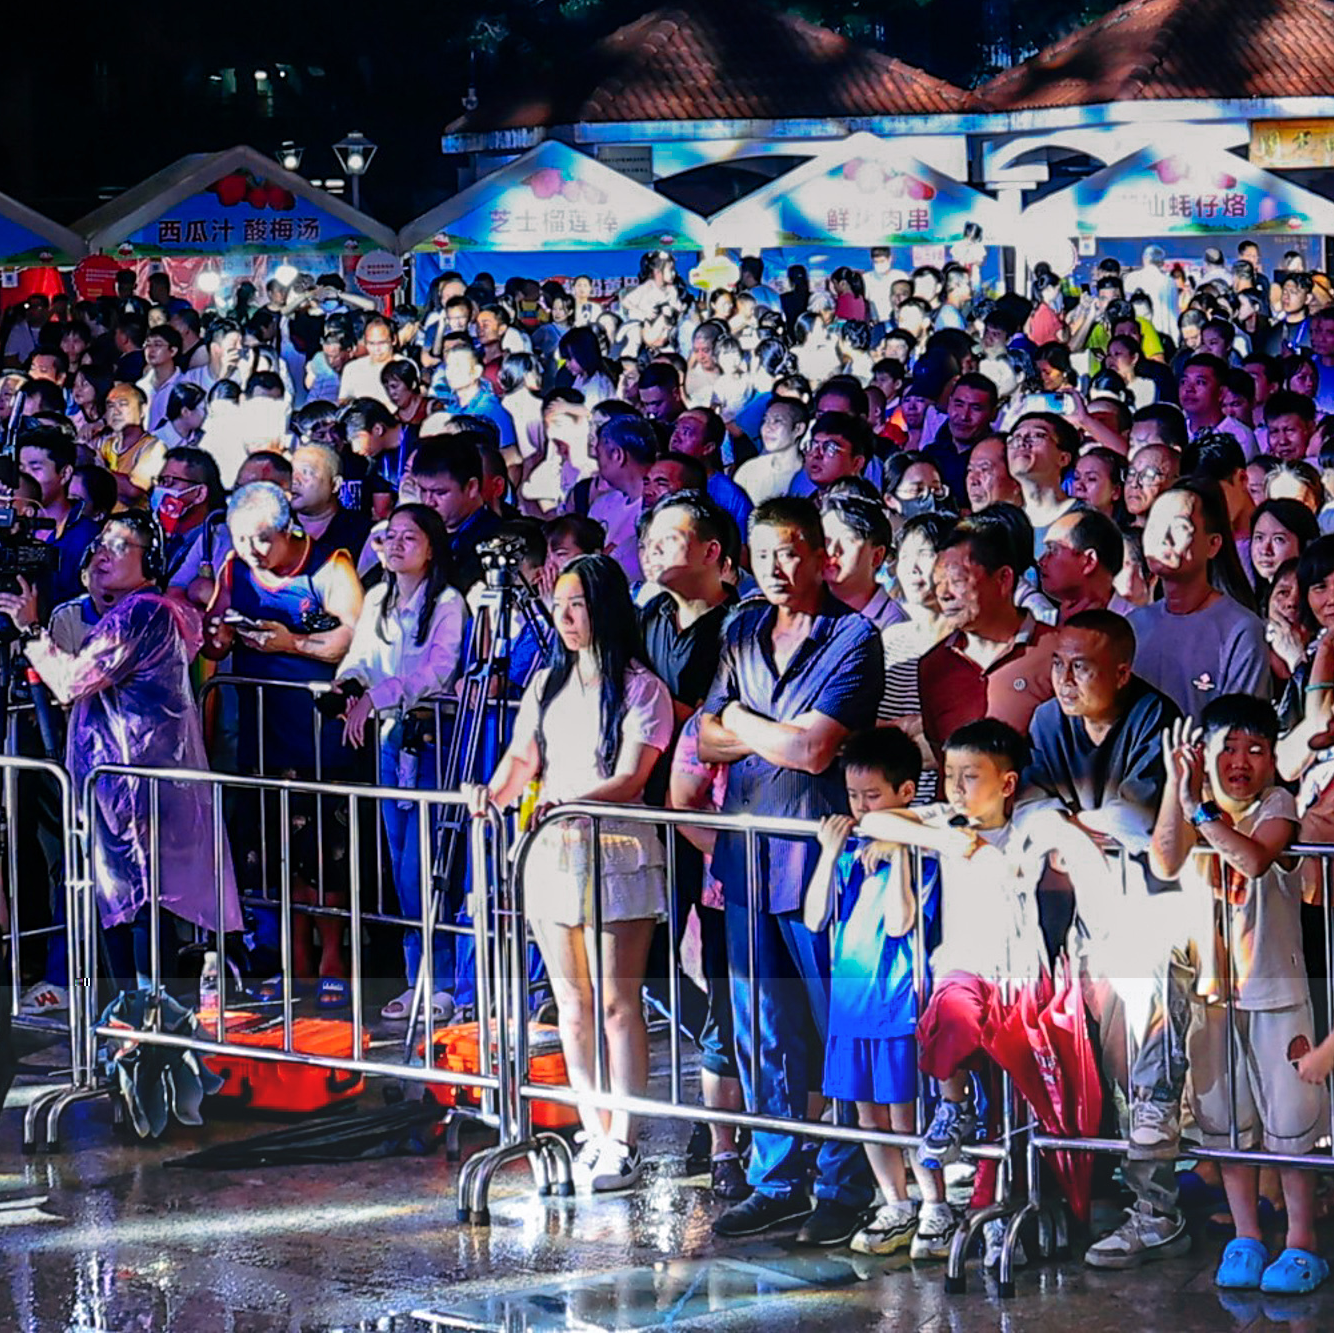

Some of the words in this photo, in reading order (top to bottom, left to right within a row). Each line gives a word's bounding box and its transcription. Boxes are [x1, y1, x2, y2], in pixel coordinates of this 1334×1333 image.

[158, 219, 236, 244] 西瓜汁
[243, 217, 321, 242] 酸梅汤
